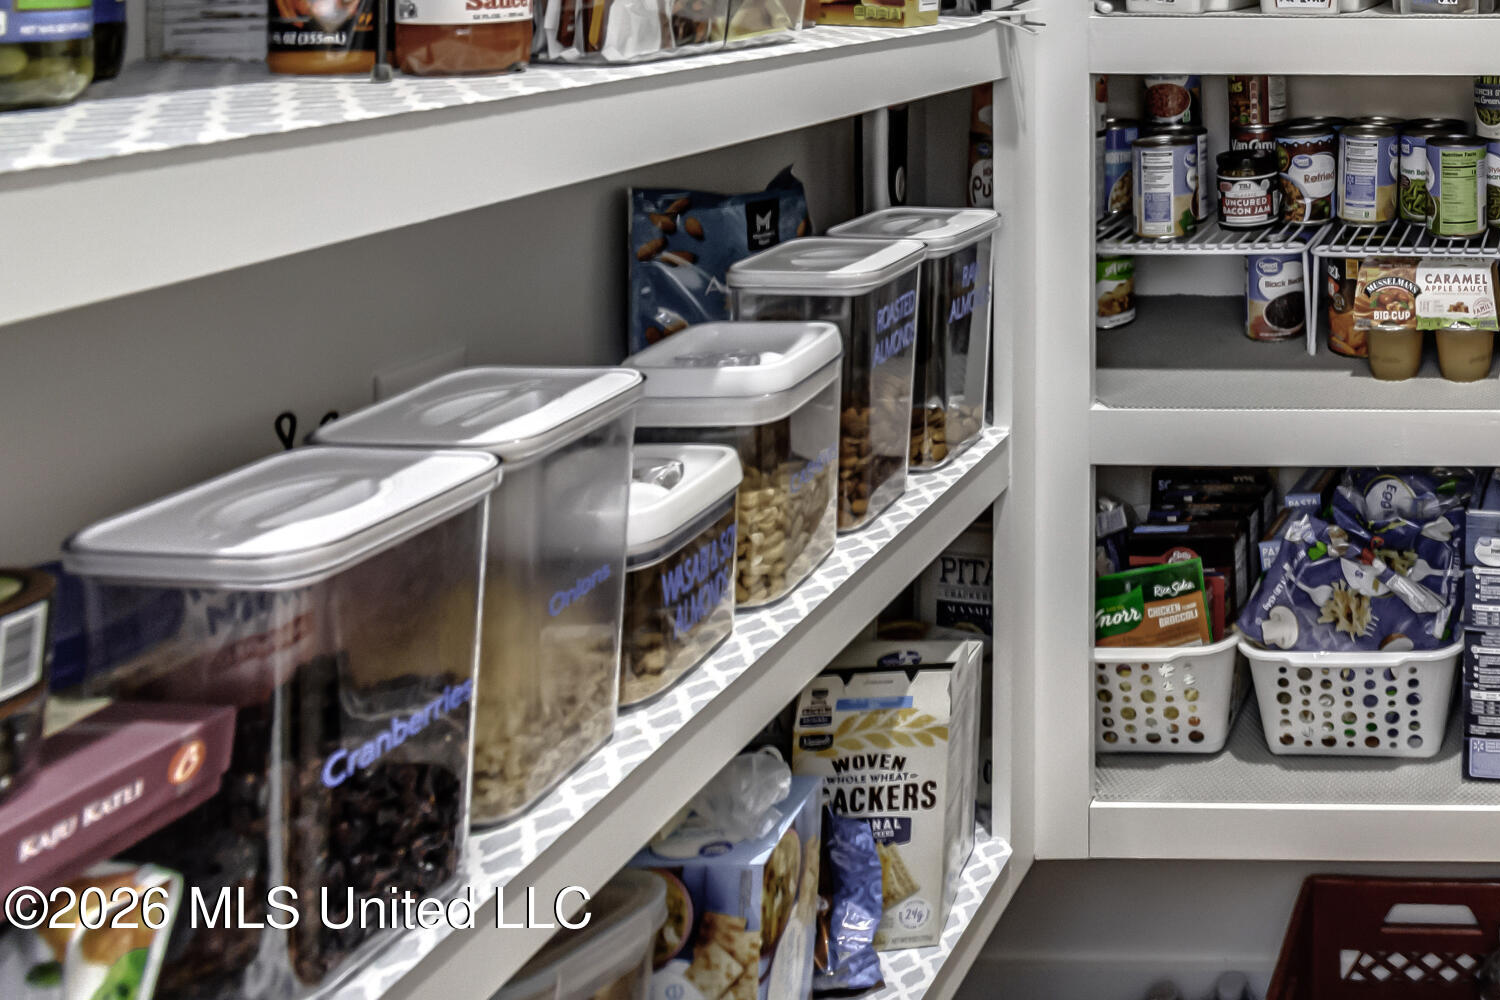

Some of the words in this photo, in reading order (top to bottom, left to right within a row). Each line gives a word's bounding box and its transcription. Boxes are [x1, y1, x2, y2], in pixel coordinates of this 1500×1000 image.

[1303, 170, 1336, 184] Refried
[1225, 197, 1267, 207] UNCURED
[1265, 279, 1286, 288] Black
[1425, 273, 1488, 285] CARAMEL
[1424, 285, 1453, 293] APPLE
[1457, 285, 1488, 294] SAUCE
[876, 289, 916, 333] ROASTED
[1373, 311, 1390, 320] BIG
[1392, 311, 1411, 320] CUP
[549, 564, 612, 617] Onions
[1153, 584, 1171, 597] Rice
[1148, 602, 1181, 619] CHICKEN
[1159, 609, 1199, 629] BROCCOLI
[320, 678, 474, 789] Cranberries
[832, 753, 907, 773] WOVEN
[826, 775, 866, 785] WHOLE
[870, 772, 909, 784] WHEAT
[822, 780, 938, 816] ACKERS
[18, 816, 79, 865] KAJU
